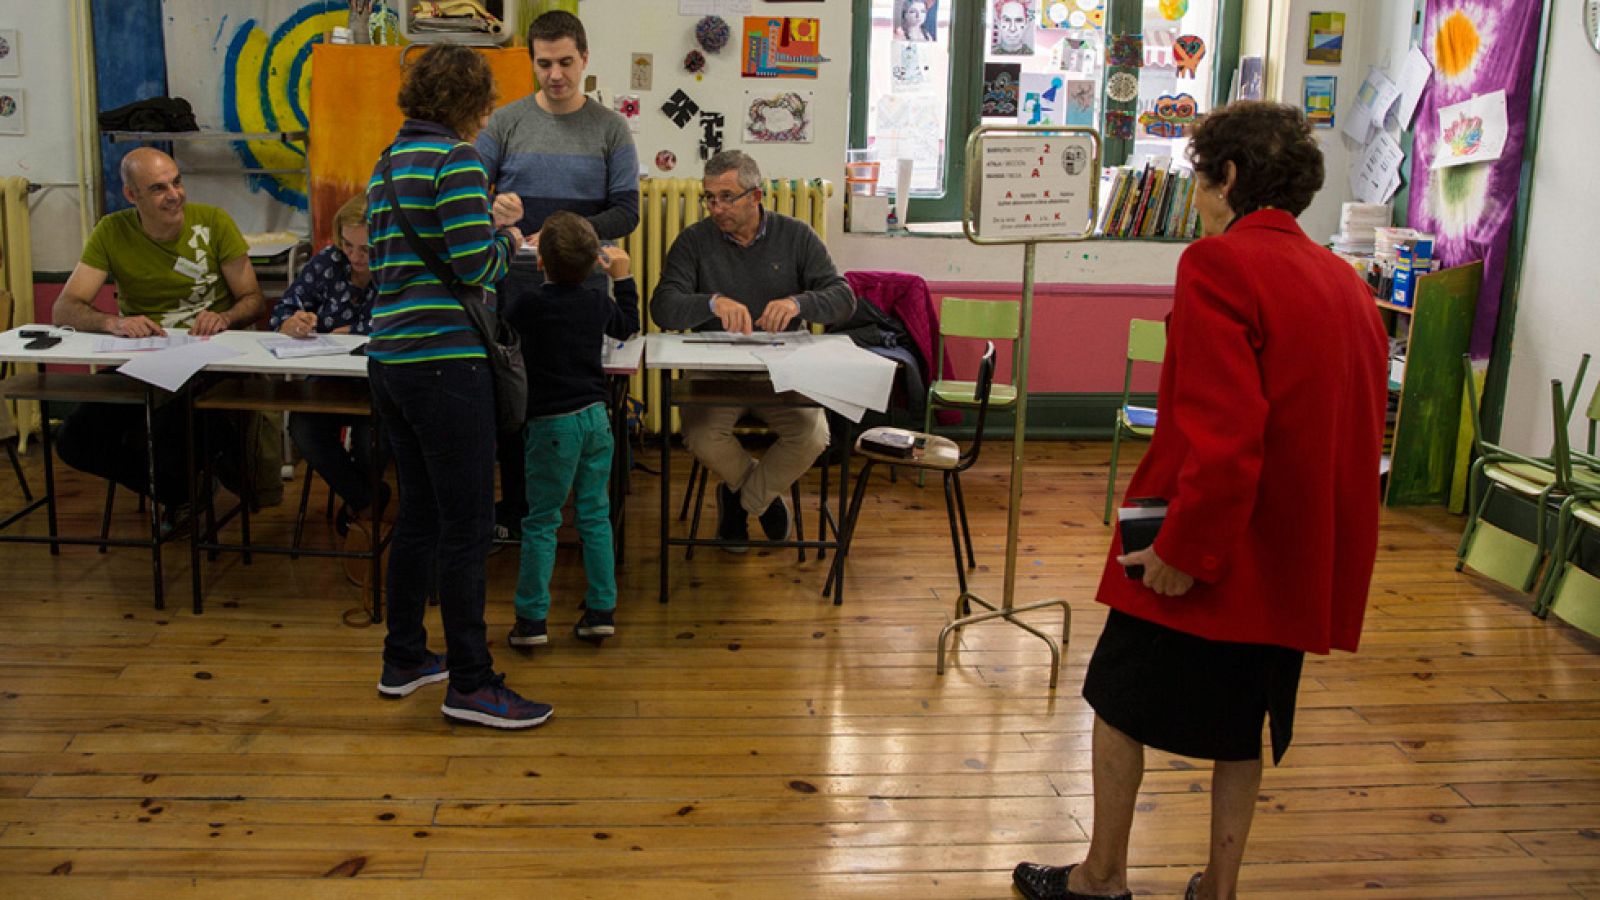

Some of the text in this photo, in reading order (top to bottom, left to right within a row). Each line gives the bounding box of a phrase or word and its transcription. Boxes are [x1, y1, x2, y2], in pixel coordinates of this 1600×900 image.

[1043, 144, 1051, 153] 2
[1038, 156, 1044, 166] 1
[1031, 168, 1040, 178] A
[1024, 214, 1032, 222] A
[1054, 212, 1061, 220] K
